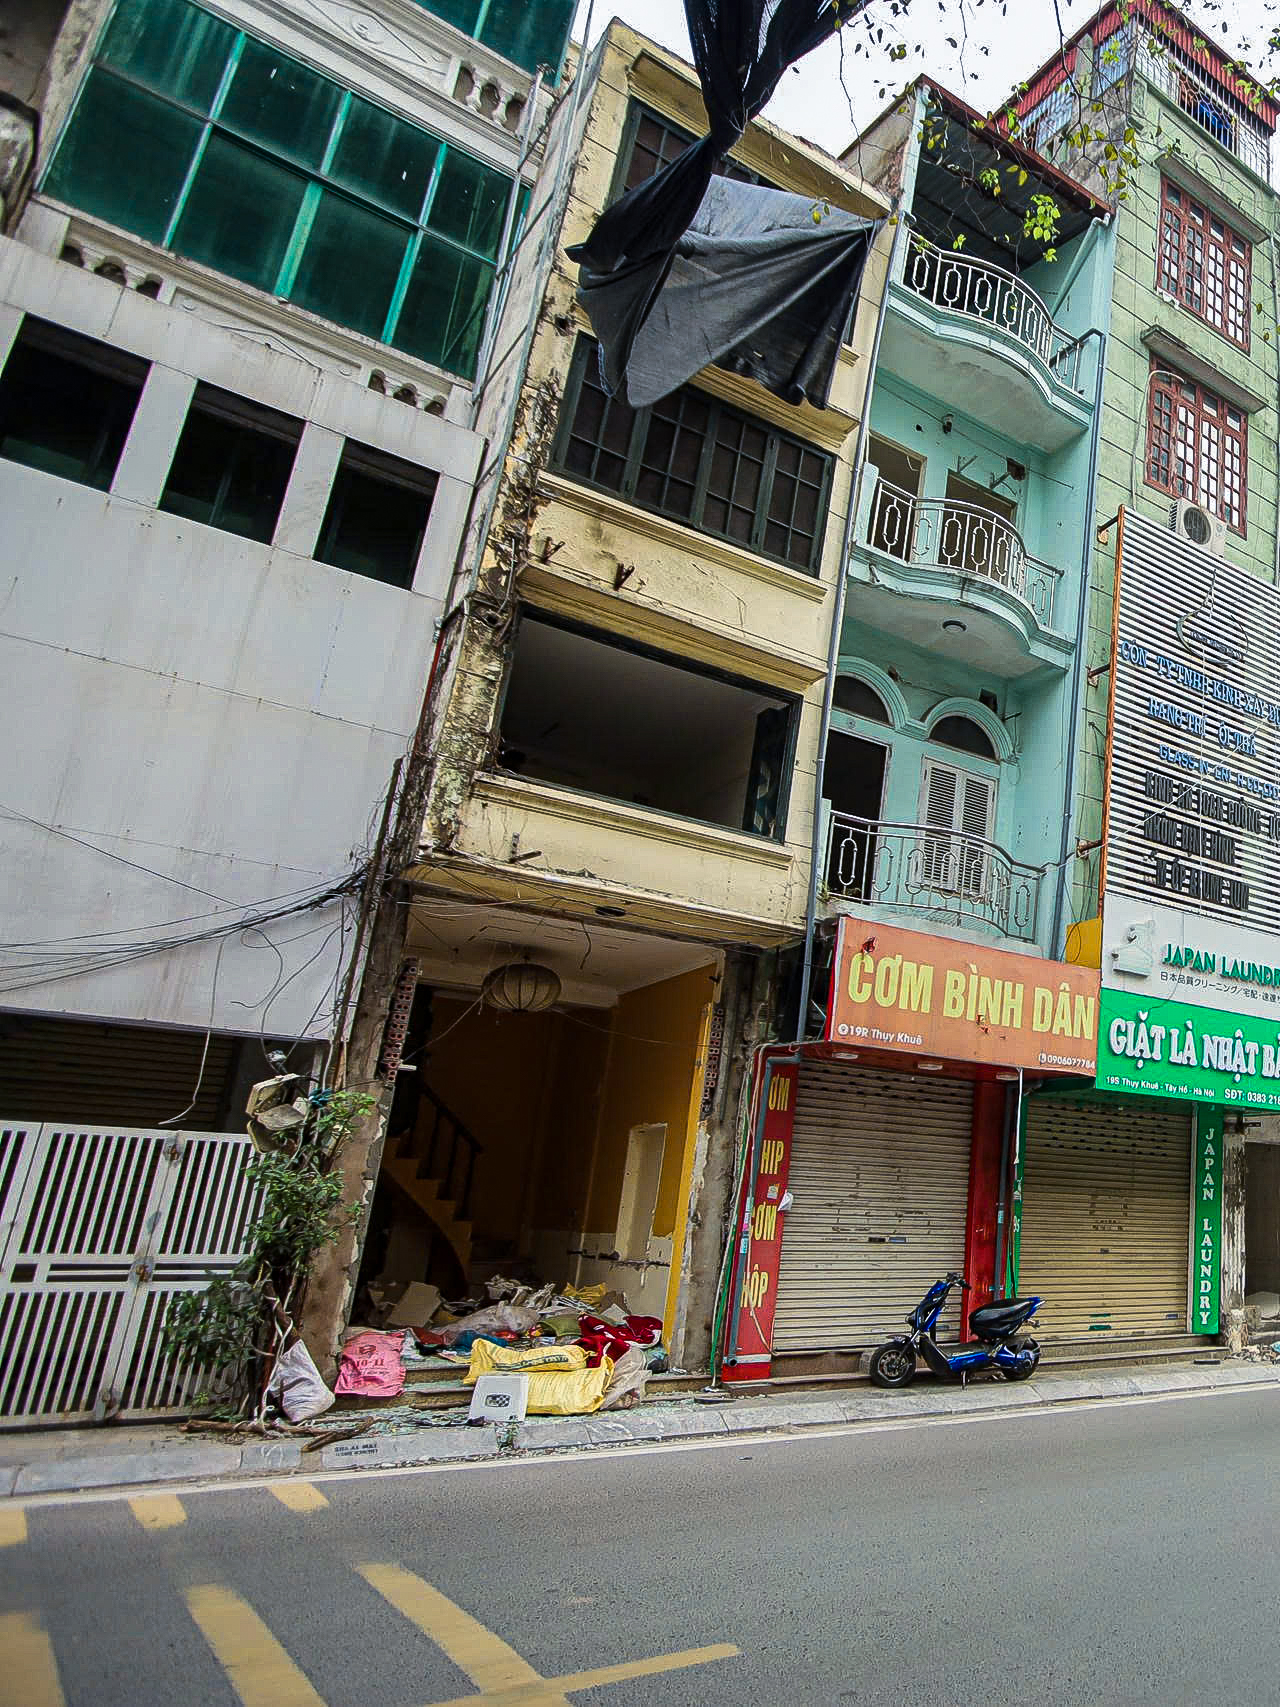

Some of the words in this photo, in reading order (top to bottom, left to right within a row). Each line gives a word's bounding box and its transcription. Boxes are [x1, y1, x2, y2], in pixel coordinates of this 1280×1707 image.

[1157, 656, 1173, 679] TY
[1175, 665, 1209, 697] TNHH
[1159, 743, 1197, 770] GLASS
[1162, 943, 1216, 973] JAPAN
[848, 952, 934, 1013] CƠM
[943, 963, 1024, 1029] BÌNH
[1031, 982, 1095, 1040] DÂN
[897, 1032, 922, 1045] Khuê
[1109, 1010, 1166, 1069] GIẶT
[1169, 1020, 1198, 1066] LÀ
[1202, 1028, 1259, 1083] NHẬT
[761, 1073, 791, 1112] ƠM
[1224, 1088, 1245, 1101] SĐT:
[759, 1139, 785, 1175] HIP
[1203, 1128, 1215, 1200] JAPAN
[1200, 1218, 1215, 1325] LAUNDRY
